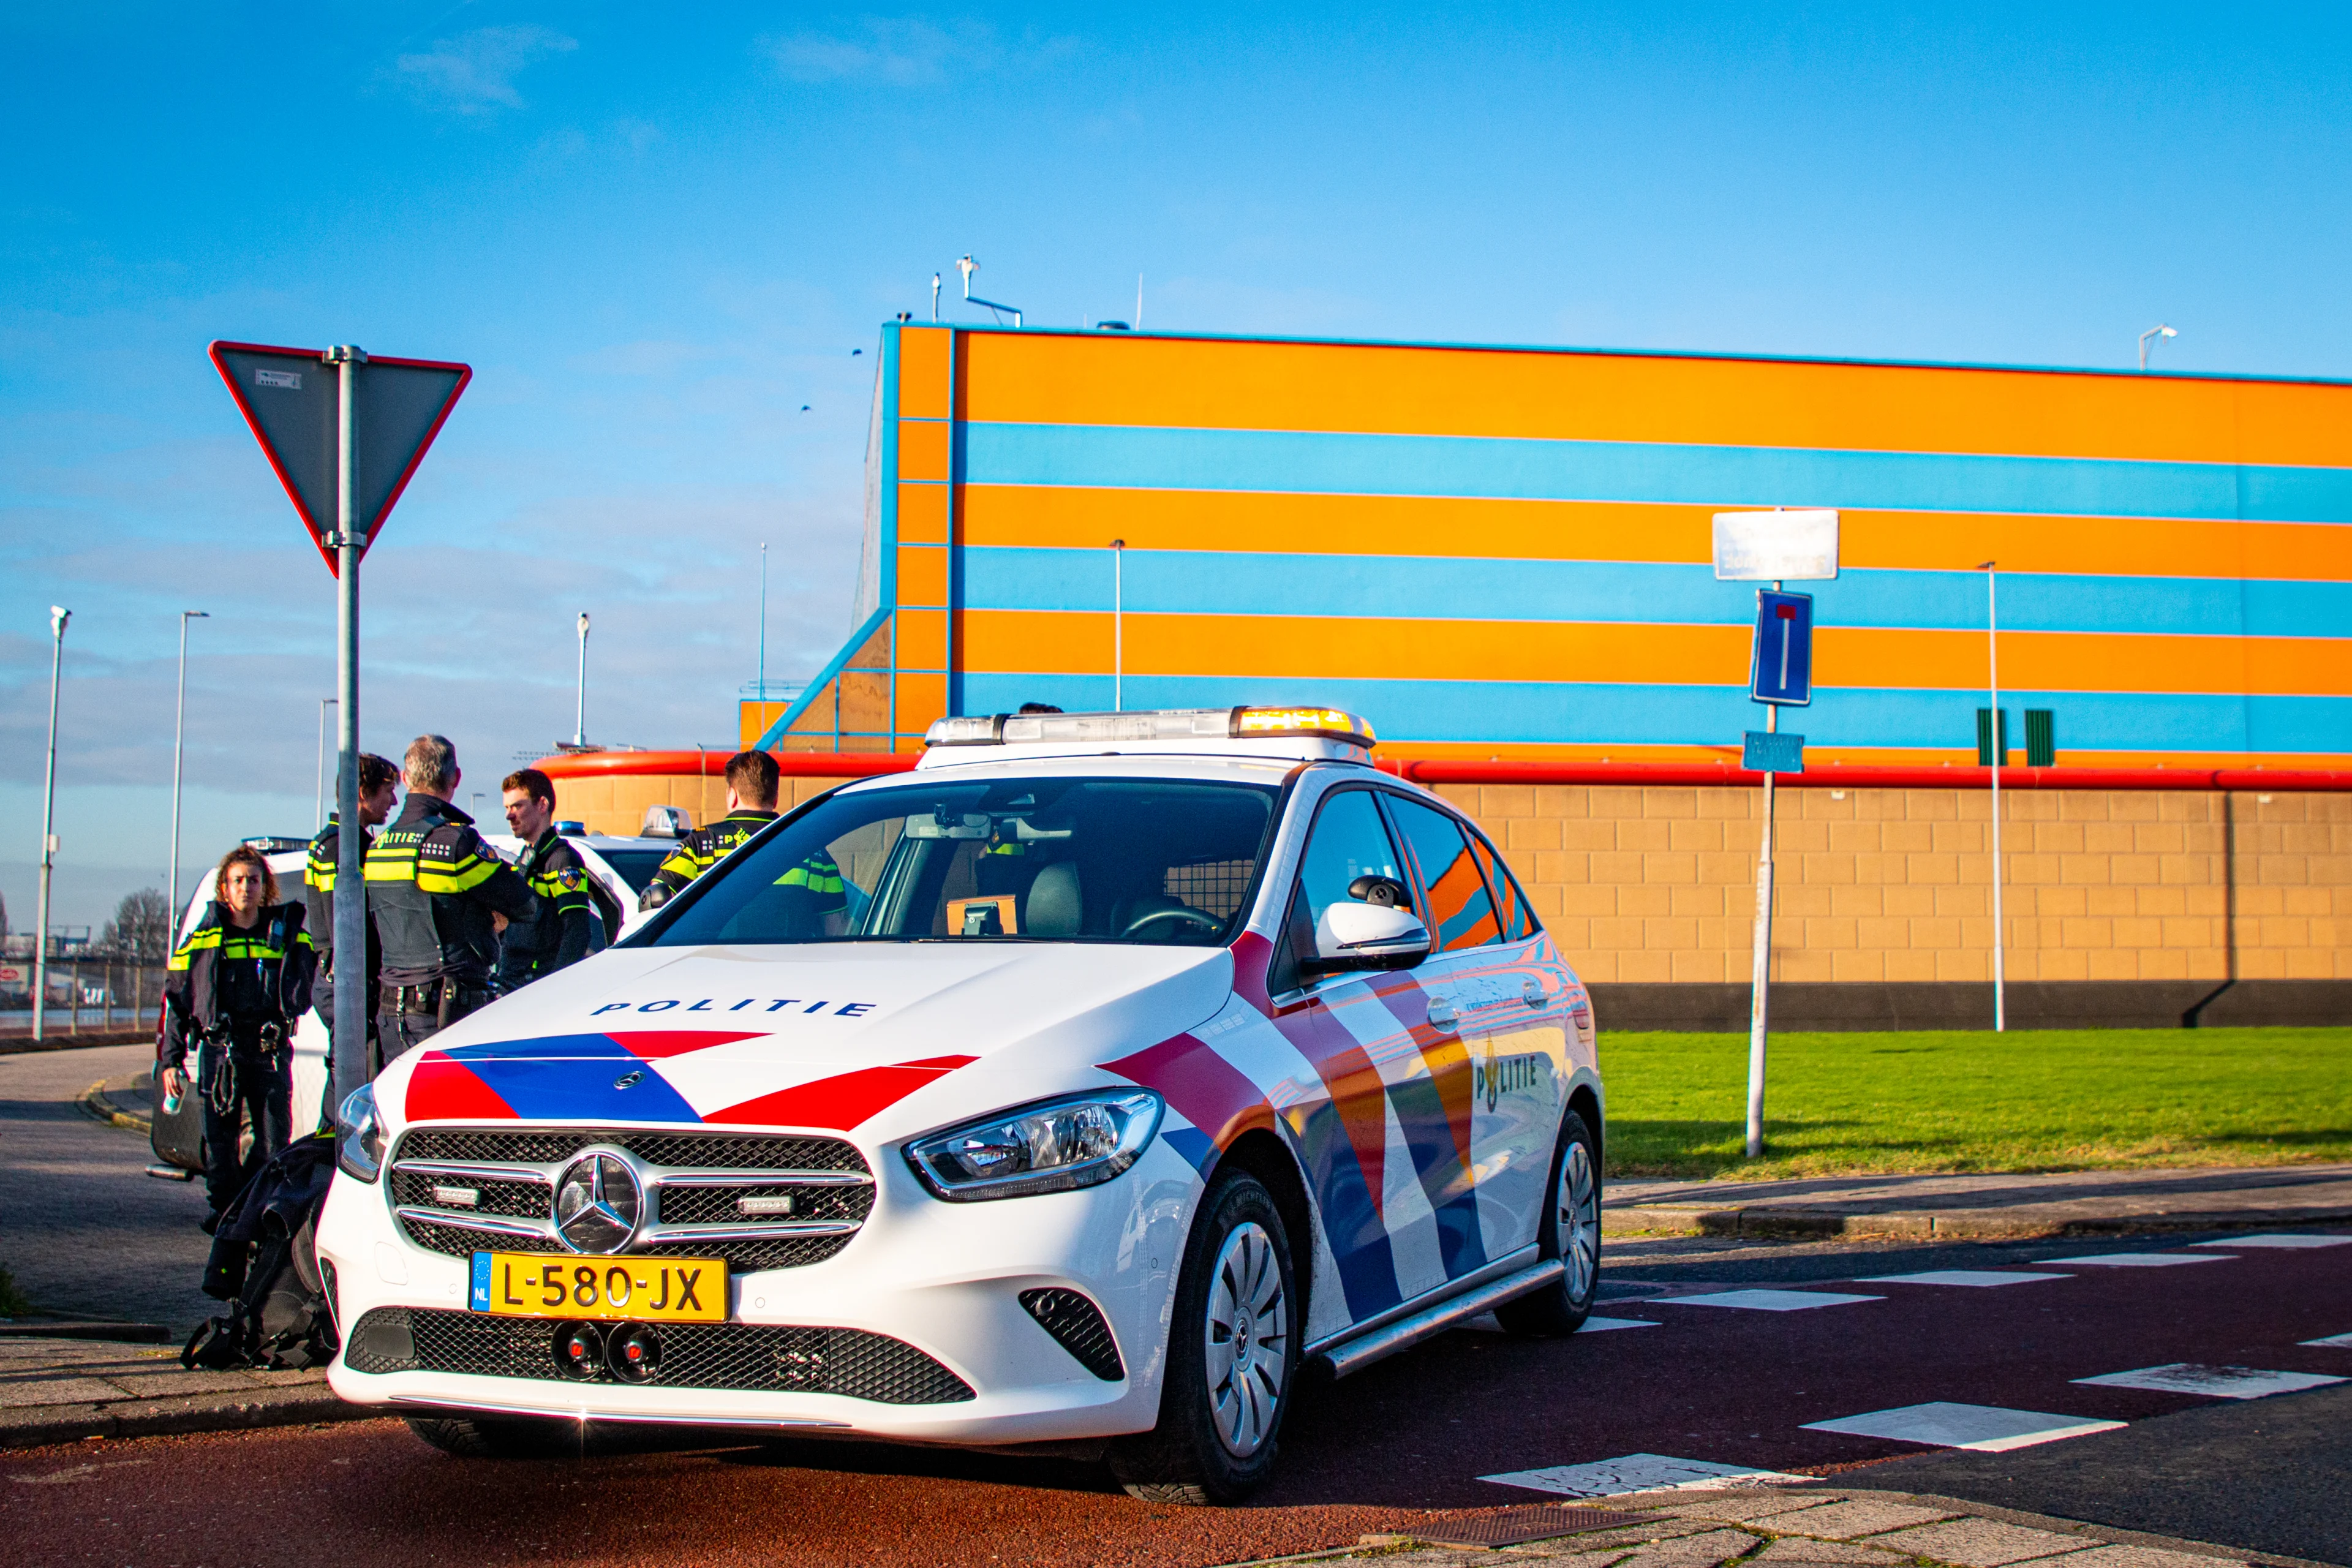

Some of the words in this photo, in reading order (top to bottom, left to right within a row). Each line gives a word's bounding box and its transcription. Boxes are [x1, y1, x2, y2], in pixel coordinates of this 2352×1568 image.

[589, 998, 877, 1017] POLITIE
[1477, 1055, 1536, 1113] POLITIE
[474, 1287, 488, 1302] NL
[504, 1262, 701, 1311] L-580-JX
